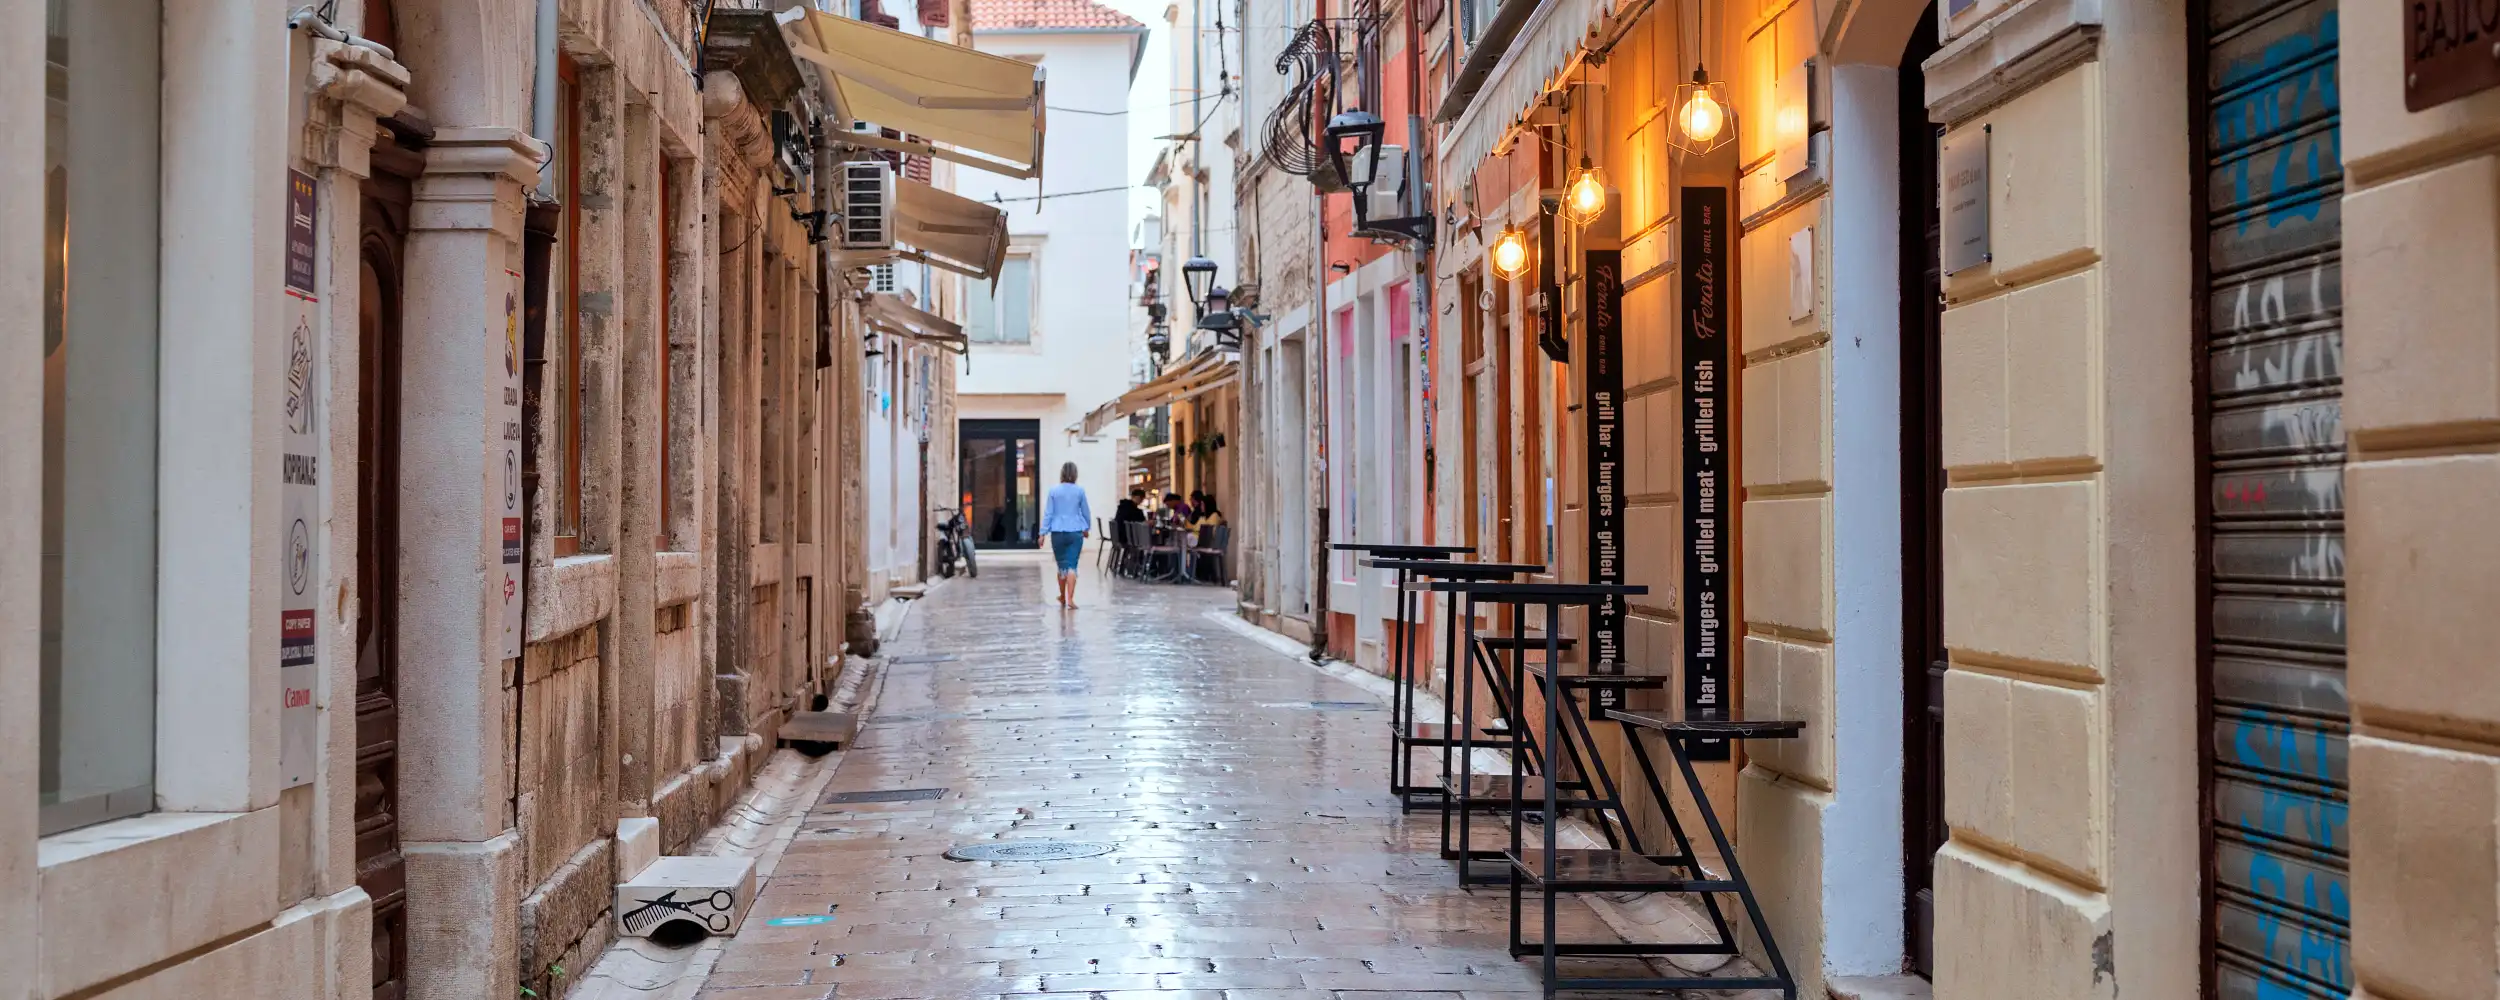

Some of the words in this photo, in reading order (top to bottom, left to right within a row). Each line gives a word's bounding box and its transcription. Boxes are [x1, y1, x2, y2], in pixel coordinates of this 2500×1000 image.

[1693, 258, 1715, 339] Ferata
[1704, 205, 1712, 225] BAR
[1694, 360, 1714, 392] fish
[1595, 391, 1614, 420] grill
[1694, 398, 1718, 452] grilled
[1599, 424, 1615, 448] bar
[282, 453, 316, 486] KOPIRANJE
[1596, 462, 1616, 517] burgers
[1697, 470, 1715, 513] meat
[1597, 531, 1617, 576] grilled
[1696, 518, 1719, 573] grilled
[1697, 591, 1719, 658] burgers
[285, 688, 311, 708] Canon
[1697, 675, 1716, 704] bar
